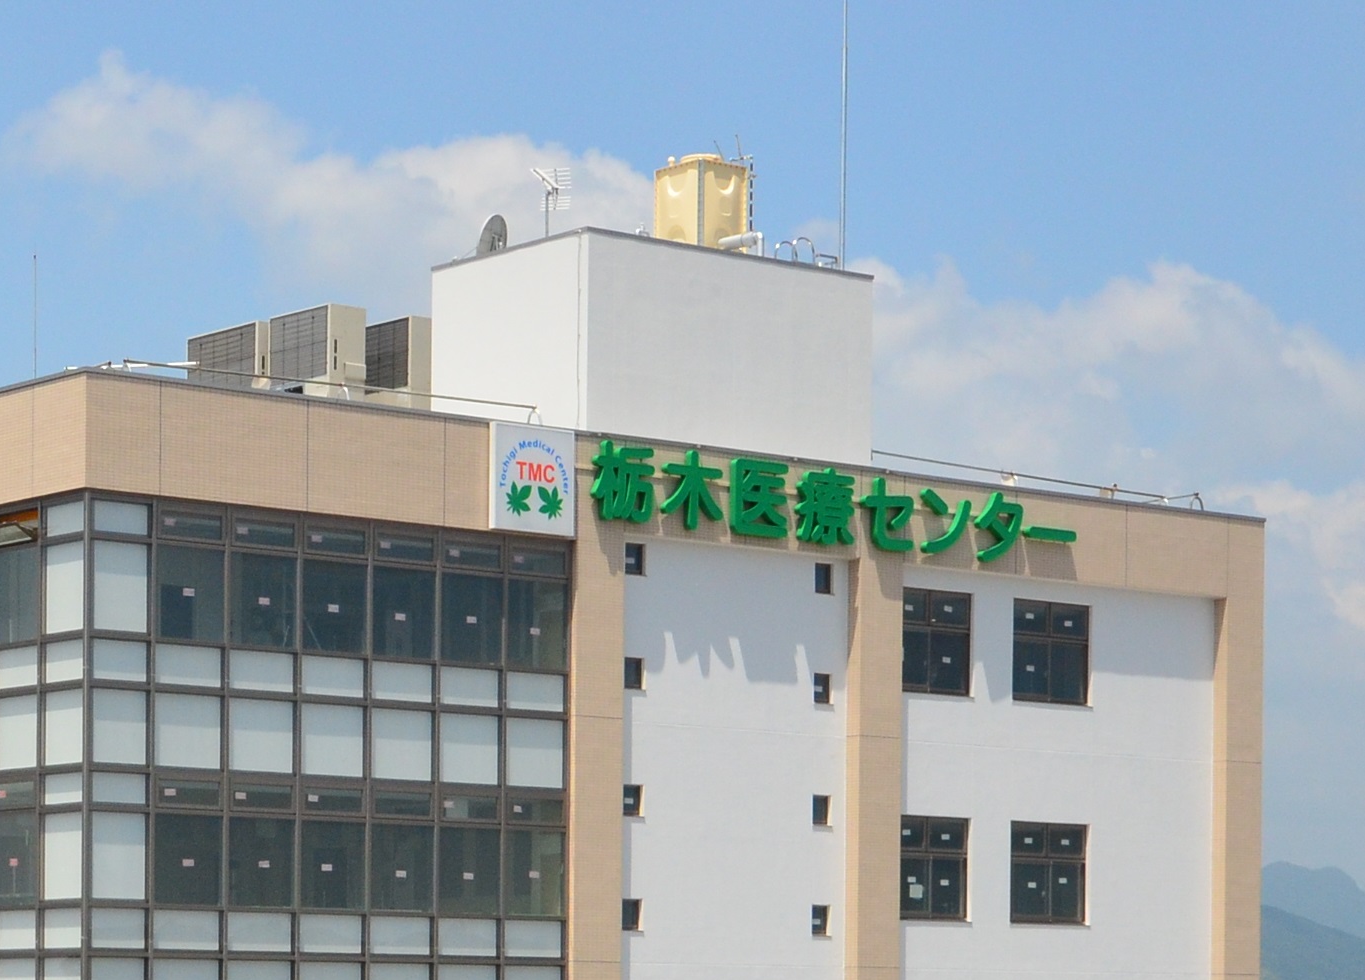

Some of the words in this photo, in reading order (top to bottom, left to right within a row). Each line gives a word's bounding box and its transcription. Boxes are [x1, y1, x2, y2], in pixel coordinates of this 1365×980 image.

[499, 446, 518, 488] Tochigi
[519, 439, 555, 456] Medical
[555, 455, 569, 495] Center
[516, 461, 555, 483] TMC
[591, 440, 1076, 562] 栃木医療センター
